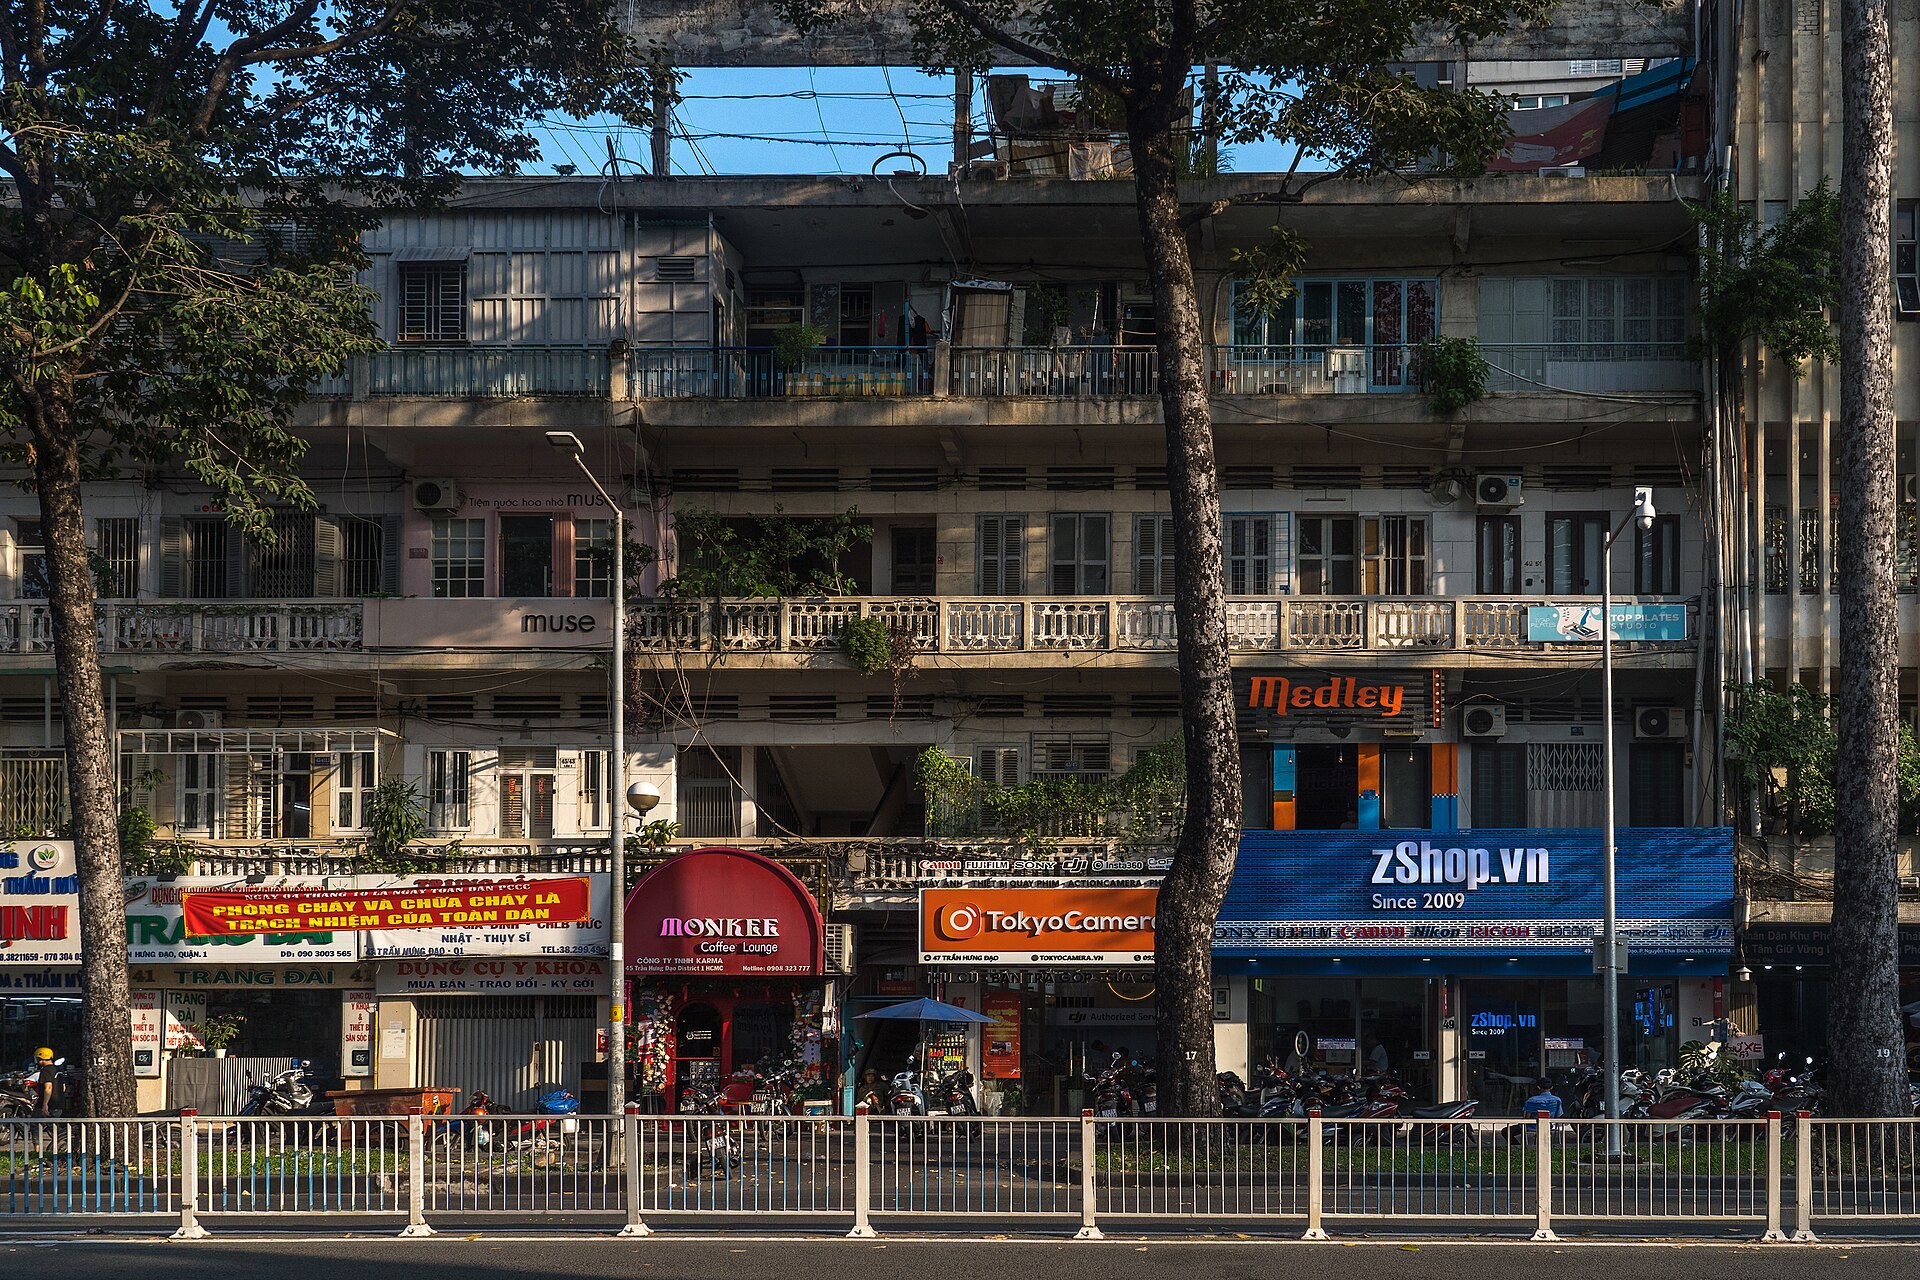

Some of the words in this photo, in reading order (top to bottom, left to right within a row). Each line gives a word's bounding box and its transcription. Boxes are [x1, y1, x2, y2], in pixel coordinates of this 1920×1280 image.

[522, 497, 542, 506] hoa
[567, 493, 616, 506] muse
[524, 613, 596, 633] muse
[1610, 614, 1632, 622] TOP
[1635, 613, 1679, 622] PILATES
[1611, 622, 1657, 630] STUDIO
[1249, 676, 1404, 716] Medley
[919, 859, 961, 870] Canon
[965, 861, 1009, 869] FUJIFILM
[1014, 861, 1056, 869] SONY
[1106, 861, 1142, 869] Insta360
[1372, 841, 1549, 890] zShop.vn
[920, 877, 940, 888] MÁY
[1010, 880, 1034, 888] QUAY
[1036, 880, 1060, 888] PHIM
[212, 903, 290, 917] PHÒNG
[298, 900, 356, 914] CHÁY
[363, 899, 394, 911] VÀ
[400, 895, 462, 910] CHỮA
[469, 893, 526, 906] CHÁY
[536, 892, 560, 905] LÀ
[1372, 893, 1416, 909] Since
[1423, 893, 1465, 909] 2009
[226, 918, 300, 931] TRÁCH
[308, 914, 380, 928] NHIỆM
[387, 912, 434, 924] CỦA
[440, 909, 498, 923] TOÀN
[506, 908, 550, 920] DÂN
[660, 917, 780, 937] MONKEE
[1340, 926, 1405, 939] Canon
[1414, 925, 1460, 939] Nikon
[1470, 926, 1530, 938] RICOH
[442, 933, 472, 945] NHẬT
[484, 934, 516, 945] THỤY
[1790, 930, 1810, 940] Khu
[701, 941, 736, 952] Coffee
[743, 941, 778, 954] Lounge
[44, 952, 58, 962] 070
[60, 952, 74, 962] 304
[132, 970, 155, 982] 41
[397, 962, 465, 978] DỤNG
[474, 962, 504, 978] CỤ
[512, 962, 528, 976] Y
[536, 962, 603, 976] KHOA
[174, 970, 275, 985] TRANG
[282, 968, 334, 984] ĐÀI
[408, 980, 435, 988] MUA
[440, 978, 466, 988] BÁN
[478, 980, 511, 988] TRAO
[516, 976, 538, 988] ĐỔI
[551, 978, 567, 988] KÝ
[168, 992, 205, 1005] TRANG
[178, 1008, 196, 1022] ĐÀI
[1090, 1012, 1136, 1021] Authorized
[1471, 1012, 1536, 1029] zShop.vn
[1443, 1019, 1454, 1029] 49
[1692, 1017, 1702, 1027] 51
[1489, 1028, 1505, 1036] 2009
[1744, 1042, 1762, 1052] XE
[1185, 1051, 1197, 1060] 17
[1876, 1049, 1890, 1058] 19
[93, 1057, 104, 1066] 15
